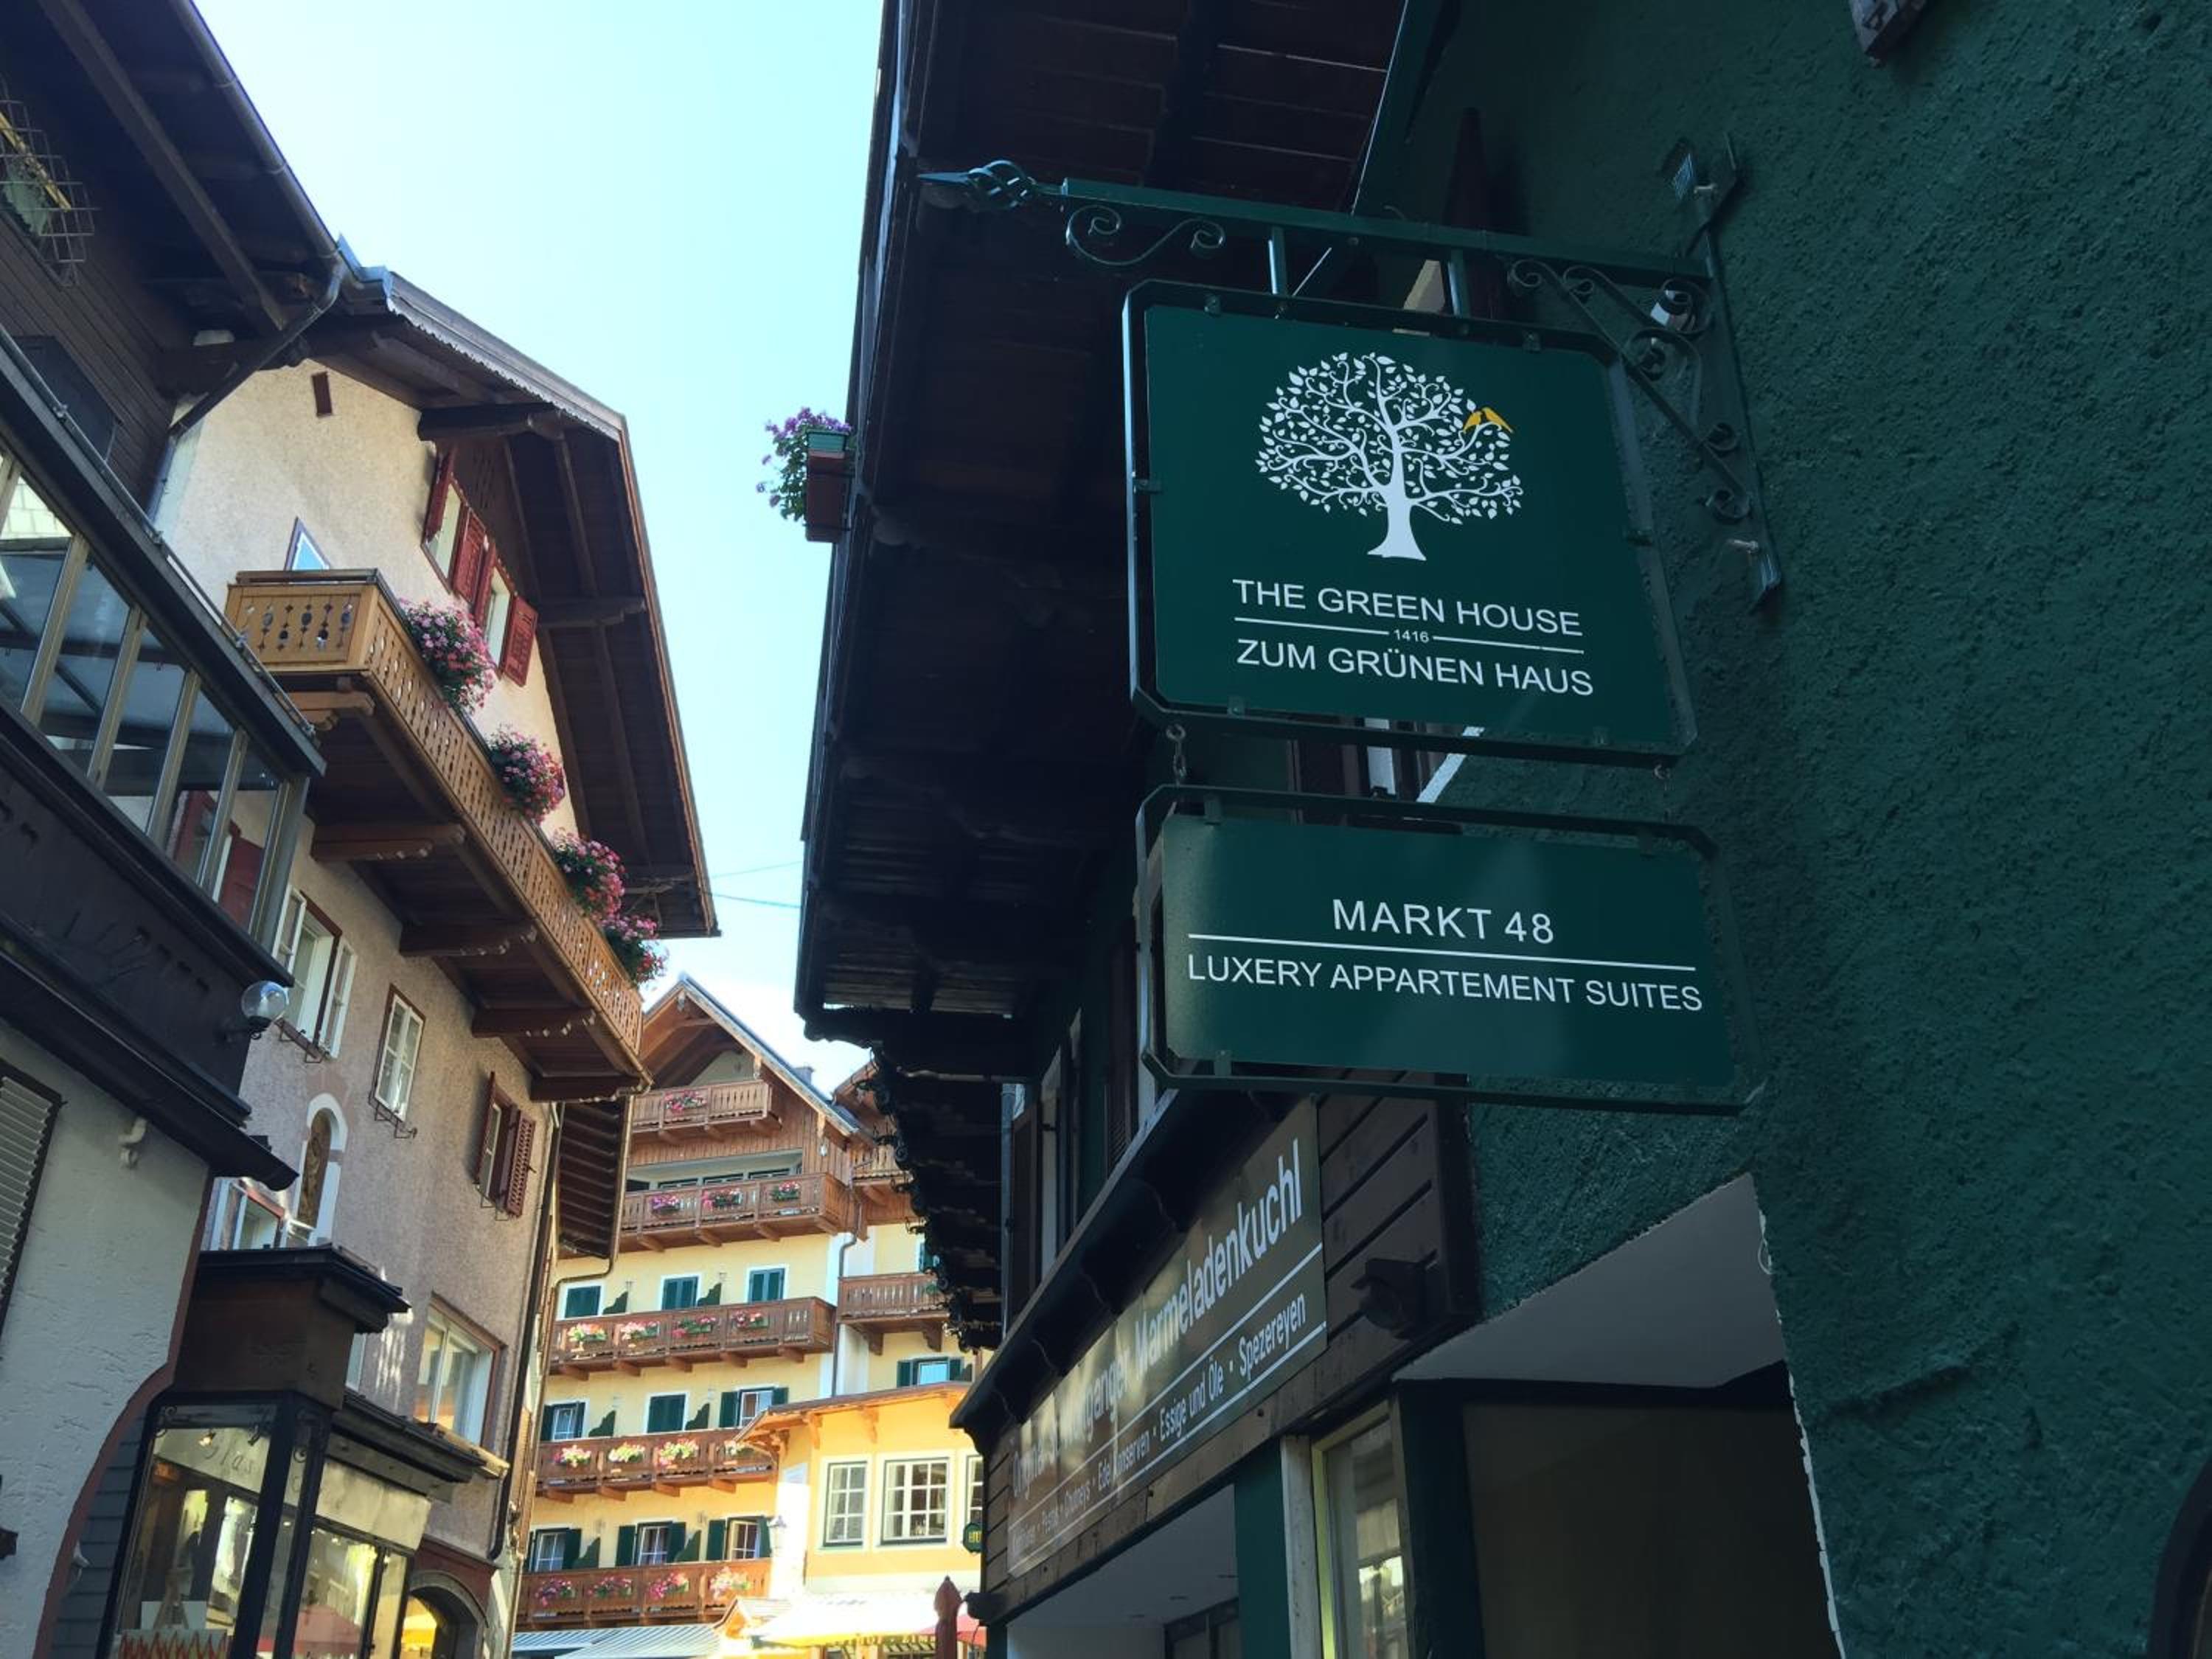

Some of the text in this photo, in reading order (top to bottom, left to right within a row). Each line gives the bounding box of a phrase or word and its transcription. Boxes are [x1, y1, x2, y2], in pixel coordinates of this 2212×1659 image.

[1233, 579, 1583, 636] THE GREEN HOUSE
[1394, 629, 1430, 643] 1416
[1237, 639, 1593, 696] ZUM GRÜNEN HAUS
[1332, 899, 1554, 945] MARKT 48
[1188, 953, 1703, 1011] LUXERY APPARTEMENT SUITES
[1134, 1137, 1302, 1382] Marmeladenkuchl
[1160, 1398, 1187, 1442] Essige
[1189, 1371, 1206, 1418] und
[1238, 1293, 1307, 1382] Spezereyen
